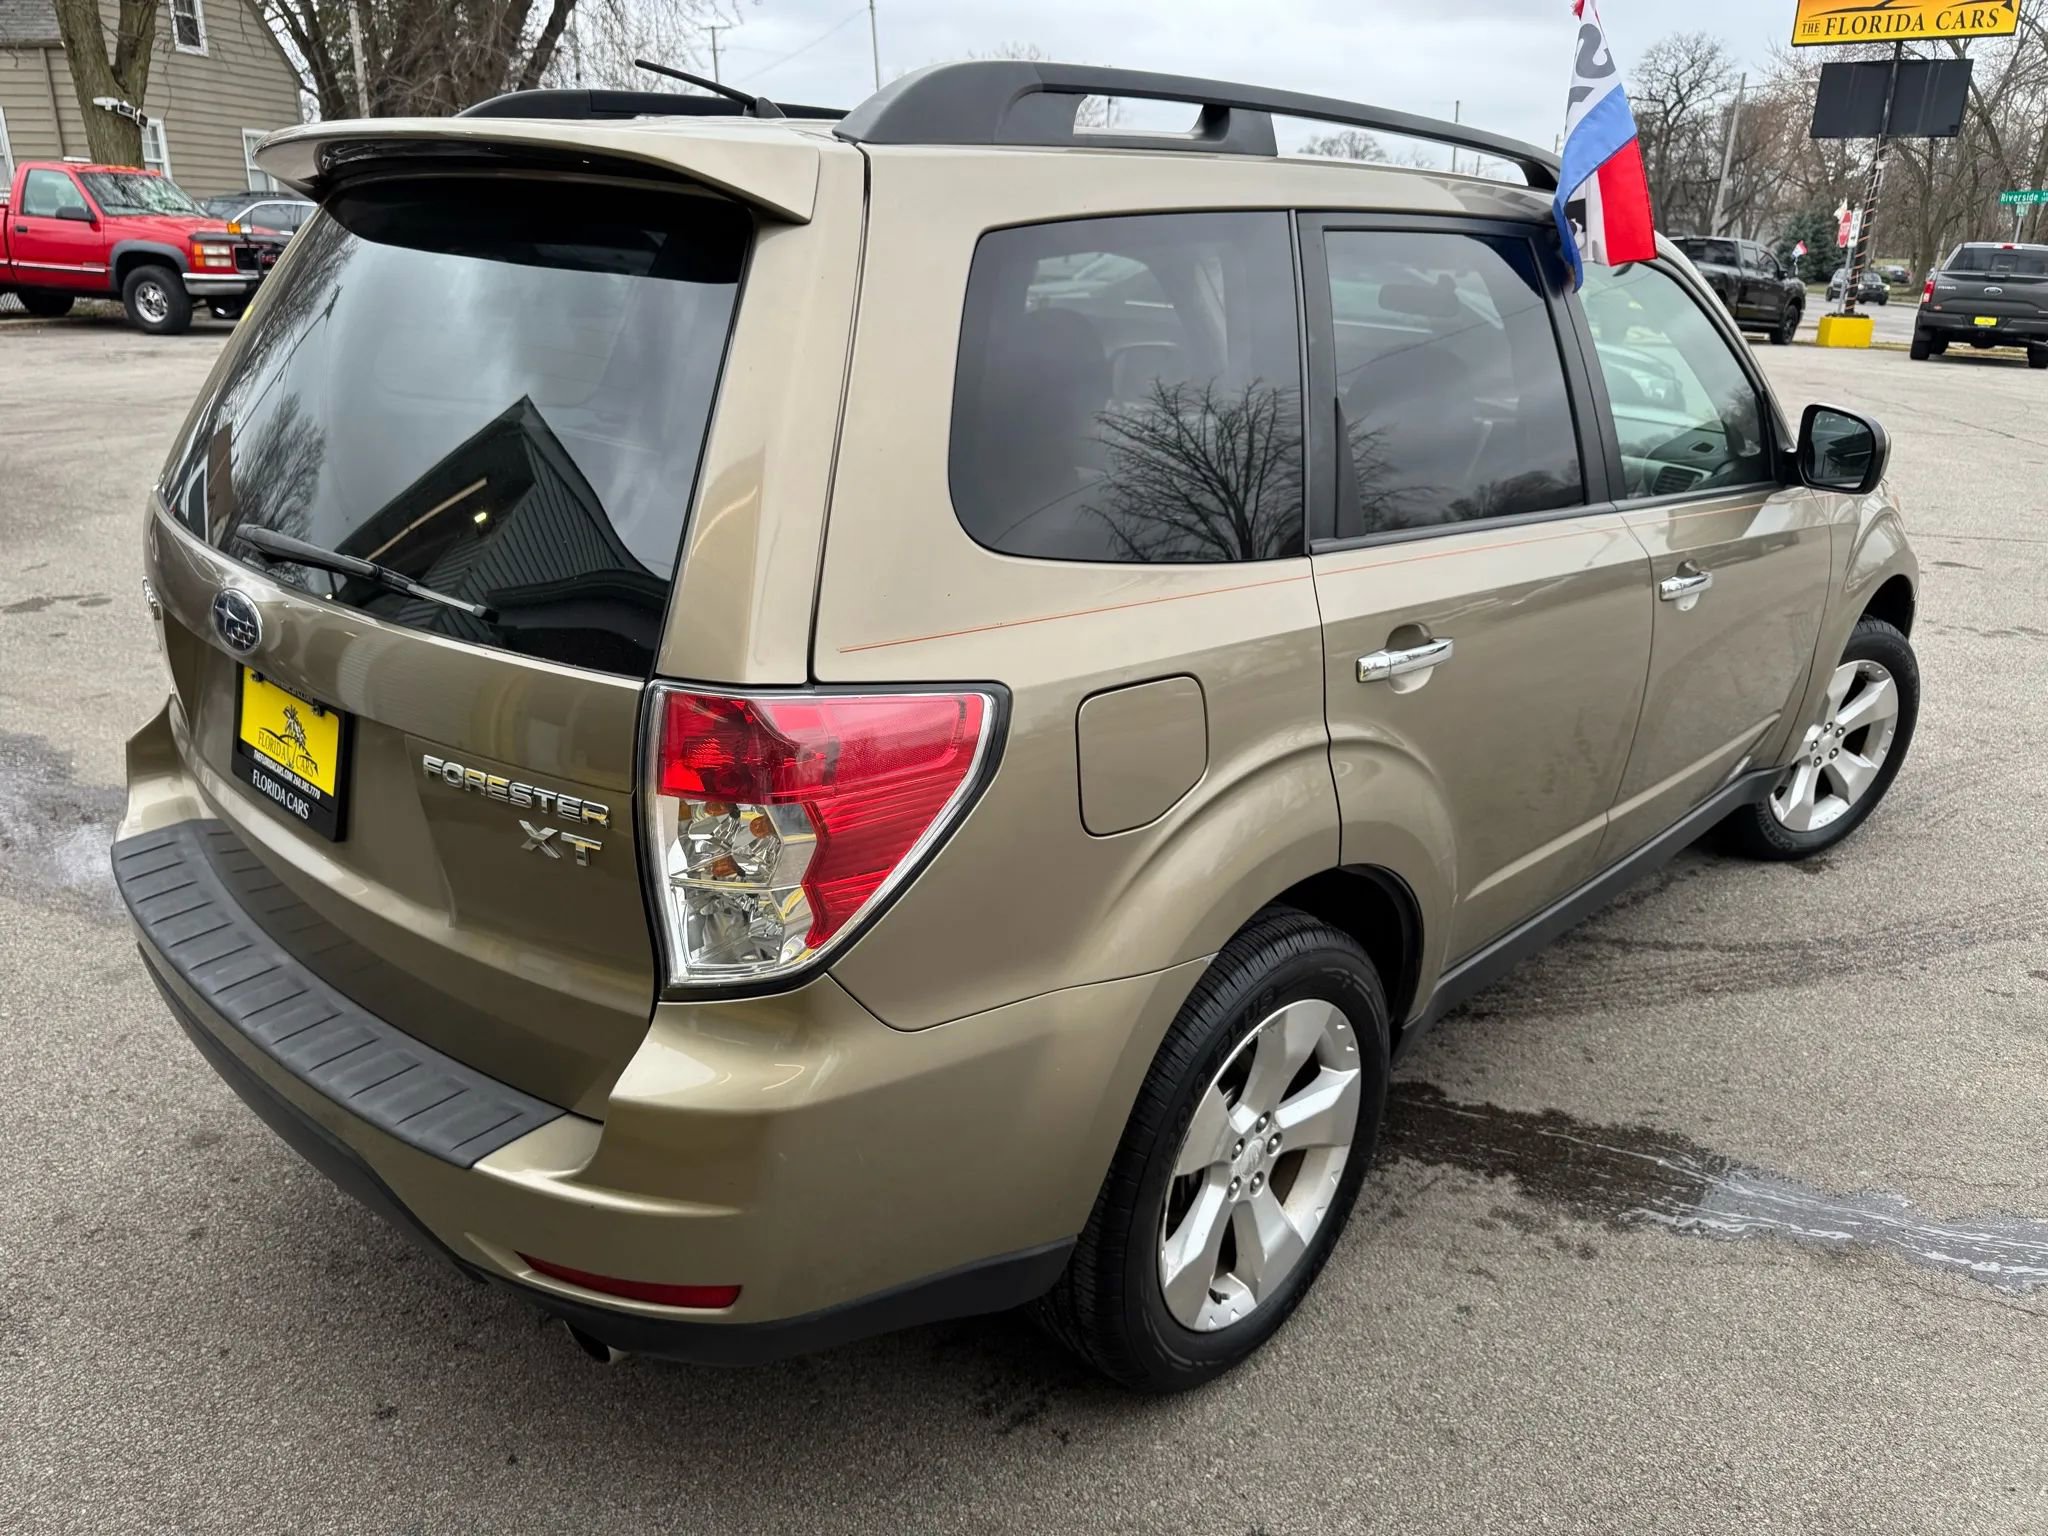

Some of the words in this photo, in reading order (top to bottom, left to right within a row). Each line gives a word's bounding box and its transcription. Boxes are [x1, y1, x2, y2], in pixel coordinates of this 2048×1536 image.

[1802, 22, 1820, 34] THE
[1824, 15, 1925, 36] FLORIDA
[1935, 8, 1999, 30] CARS
[2000, 192, 2039, 202] Riverside
[258, 730, 287, 761] FLORIDA
[296, 754, 314, 778] CARS
[253, 769, 286, 806] FLORIDA
[286, 792, 309, 820] CARS
[423, 754, 611, 829] FORESTER
[519, 819, 602, 867] XT
